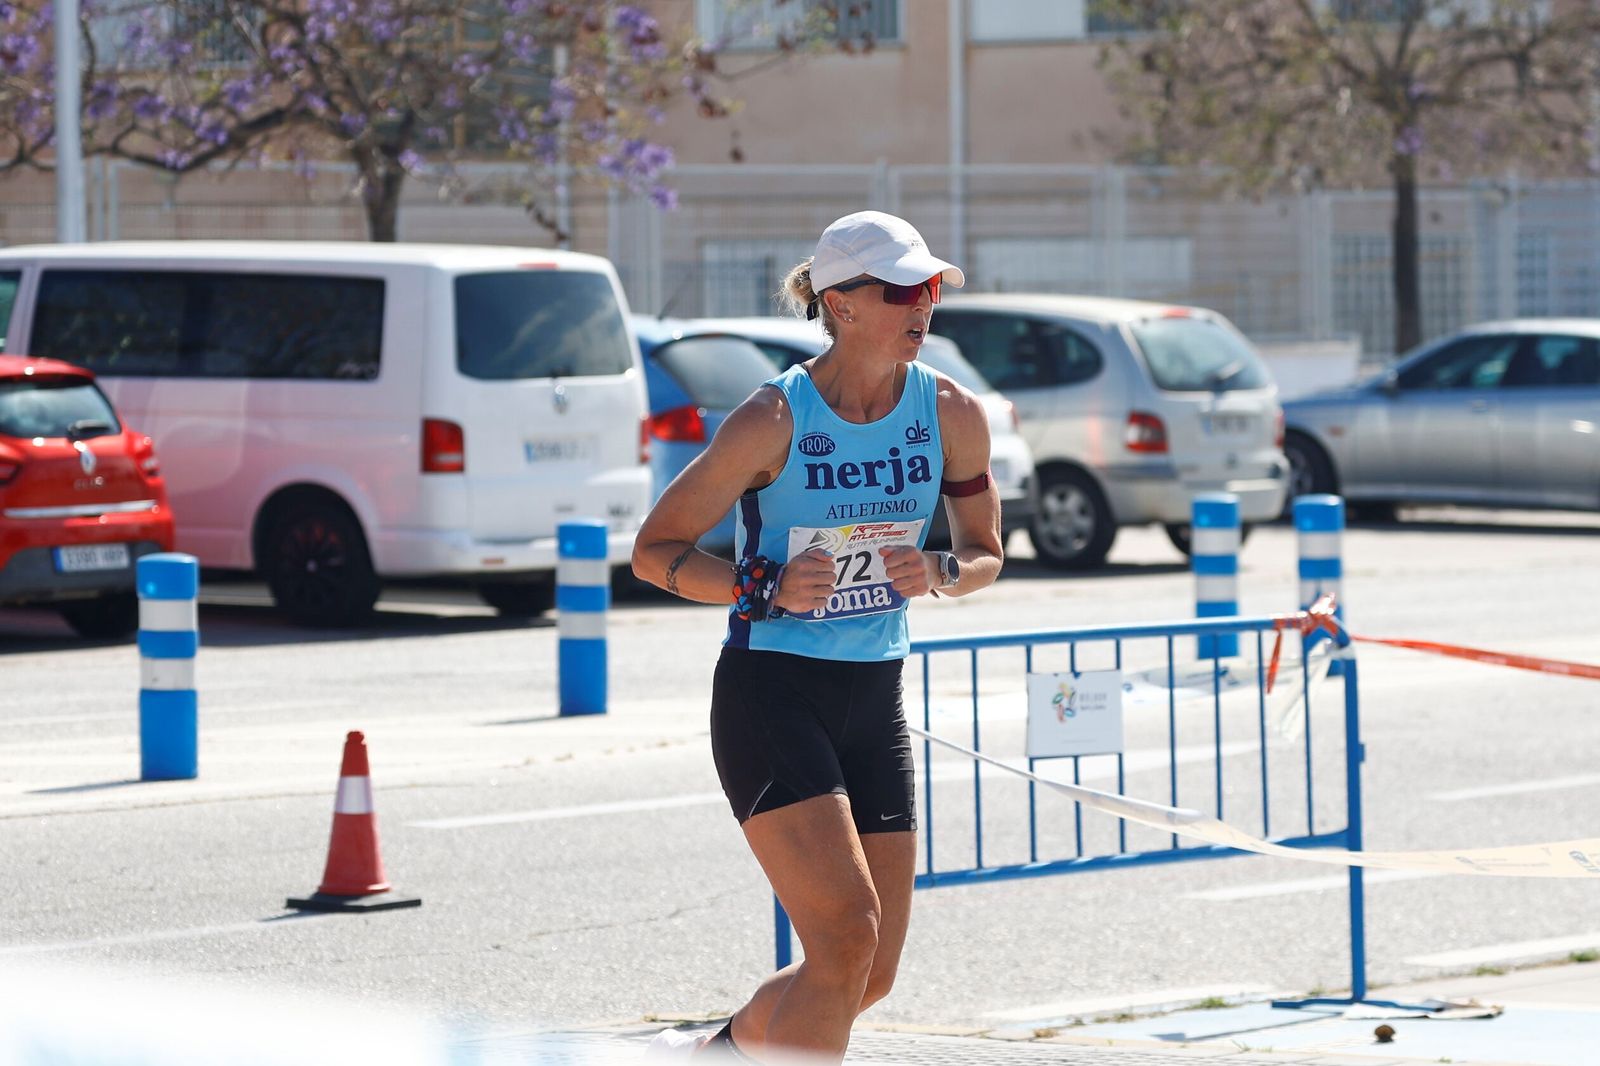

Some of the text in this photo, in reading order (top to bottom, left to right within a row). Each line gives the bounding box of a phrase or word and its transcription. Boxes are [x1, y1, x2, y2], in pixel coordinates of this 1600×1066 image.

[905, 419, 931, 445] als
[799, 436, 834, 453] TROPS
[804, 447, 932, 495] nerja
[826, 498, 918, 520] ATLETISMO
